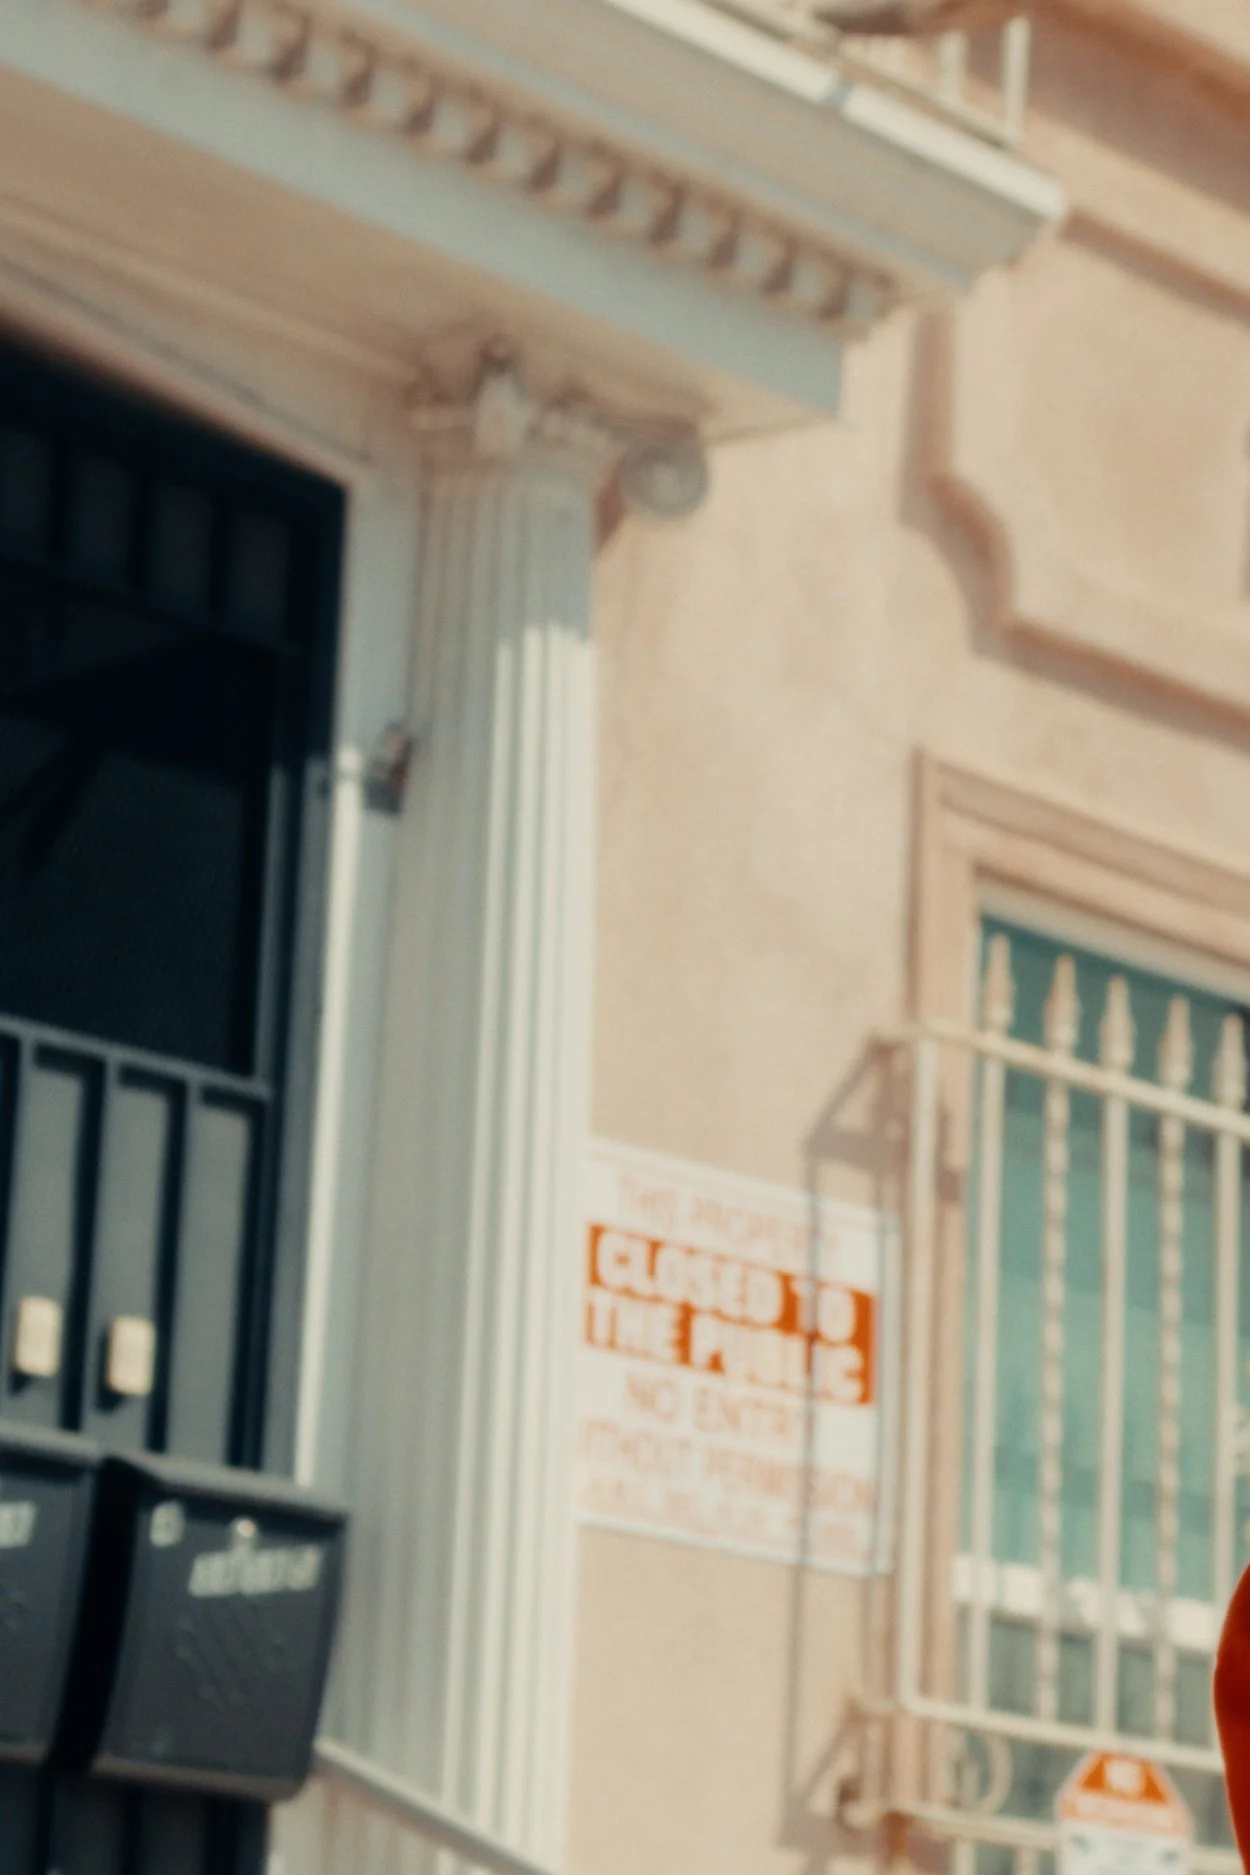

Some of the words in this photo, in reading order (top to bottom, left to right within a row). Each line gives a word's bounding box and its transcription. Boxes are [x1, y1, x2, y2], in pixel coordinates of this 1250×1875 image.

[598, 1230, 783, 1325] CLOSED
[792, 1276, 855, 1342] TO
[589, 1292, 678, 1361] THE
[689, 1310, 864, 1402] PUBLIC
[626, 1372, 677, 1424] NO
